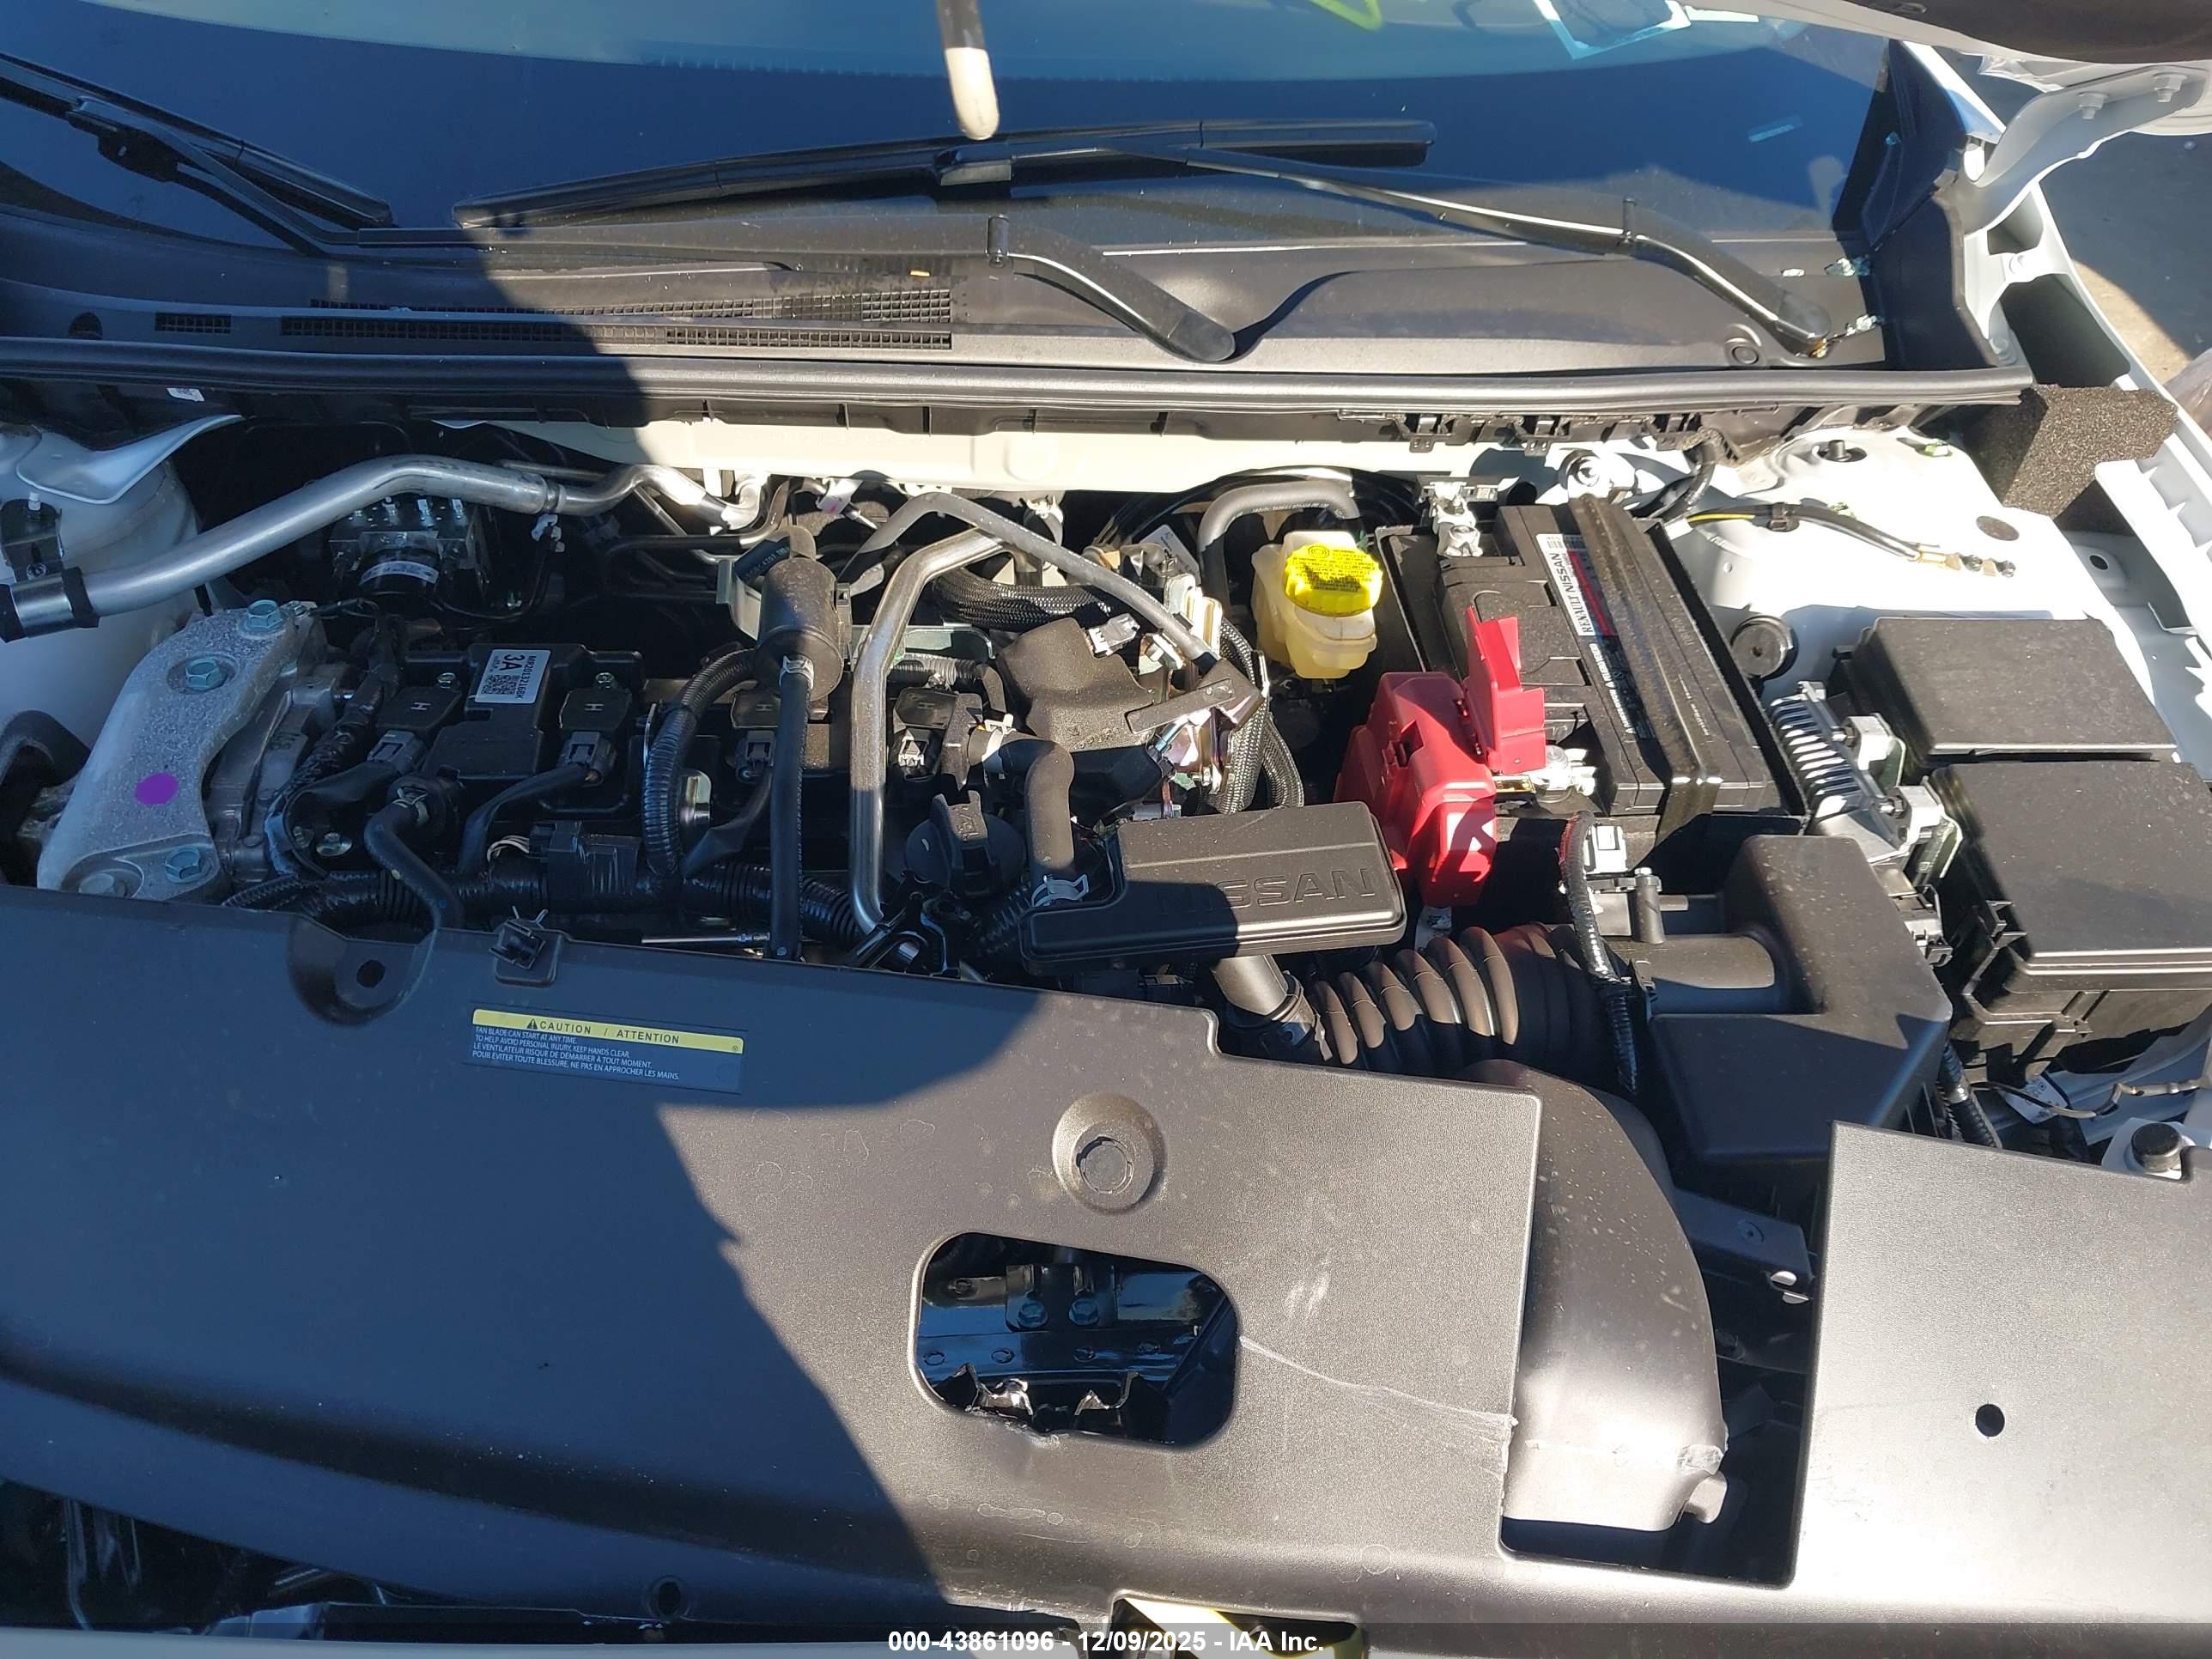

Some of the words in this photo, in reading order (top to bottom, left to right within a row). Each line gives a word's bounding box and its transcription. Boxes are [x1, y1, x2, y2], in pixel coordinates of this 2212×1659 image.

[1549, 552, 1577, 592] NISSAN
[1566, 595, 1594, 633] RENAULT
[500, 654, 525, 671] 3A
[488, 1027, 507, 1036] BLADE
[521, 1030, 539, 1040] START
[540, 1020, 592, 1035] CAUTION
[604, 1028, 609, 1036] /
[617, 1029, 680, 1044] ATTENTION
[482, 1042, 524, 1054] VENTILATEUR
[526, 1048, 549, 1057] RISQUE
[602, 1056, 619, 1065] TOUT
[484, 1035, 499, 1043] HELP
[501, 1036, 519, 1045] AVOID
[520, 1039, 550, 1048] PERSONAL
[573, 1044, 586, 1053] KEEP
[588, 1046, 610, 1055] HANDS
[473, 1050, 490, 1059] POUR
[514, 1054, 535, 1063] TOUTE
[581, 1061, 592, 1070] PAS
[605, 1064, 643, 1075] APPROCHER
